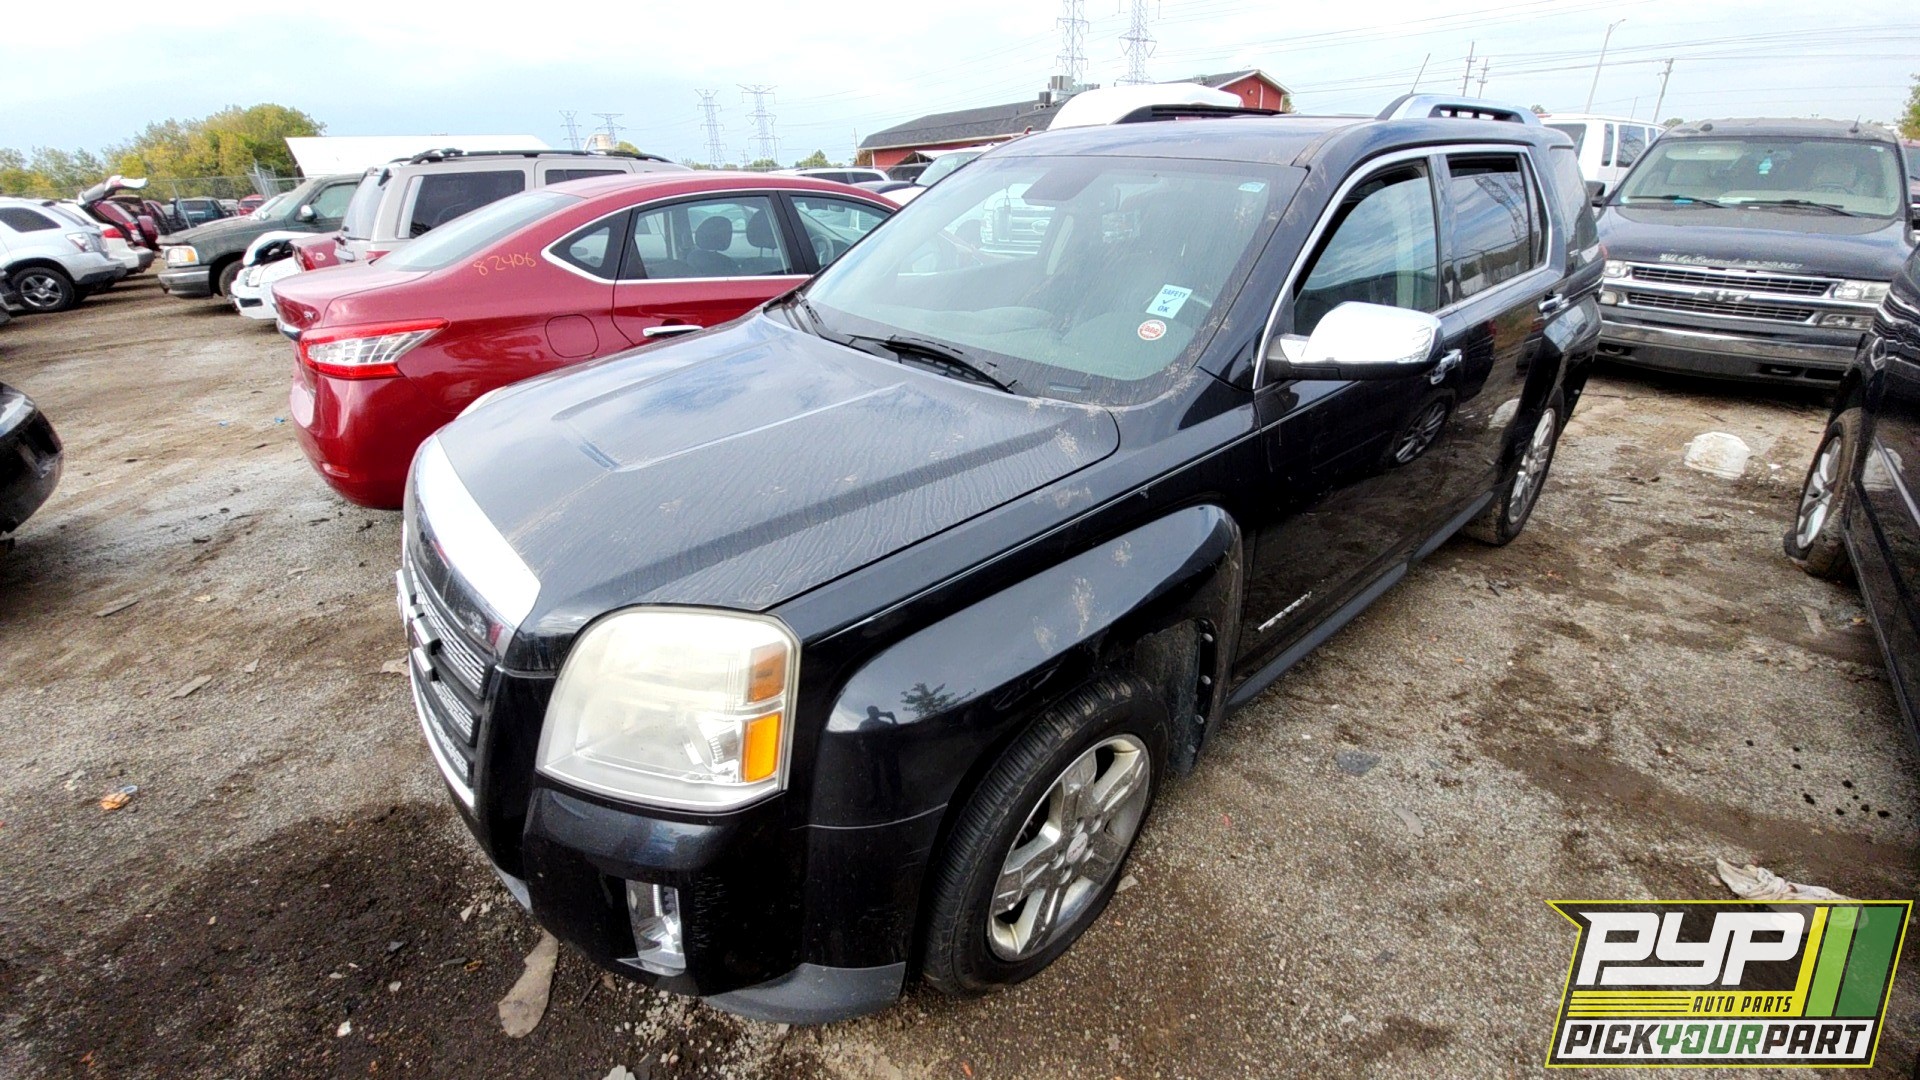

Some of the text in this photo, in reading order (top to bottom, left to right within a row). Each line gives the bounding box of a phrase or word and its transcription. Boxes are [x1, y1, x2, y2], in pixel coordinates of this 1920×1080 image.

[472, 252, 537, 276] 82406
[1161, 288, 1188, 299] SAFETY
[1157, 305, 1170, 313] OK
